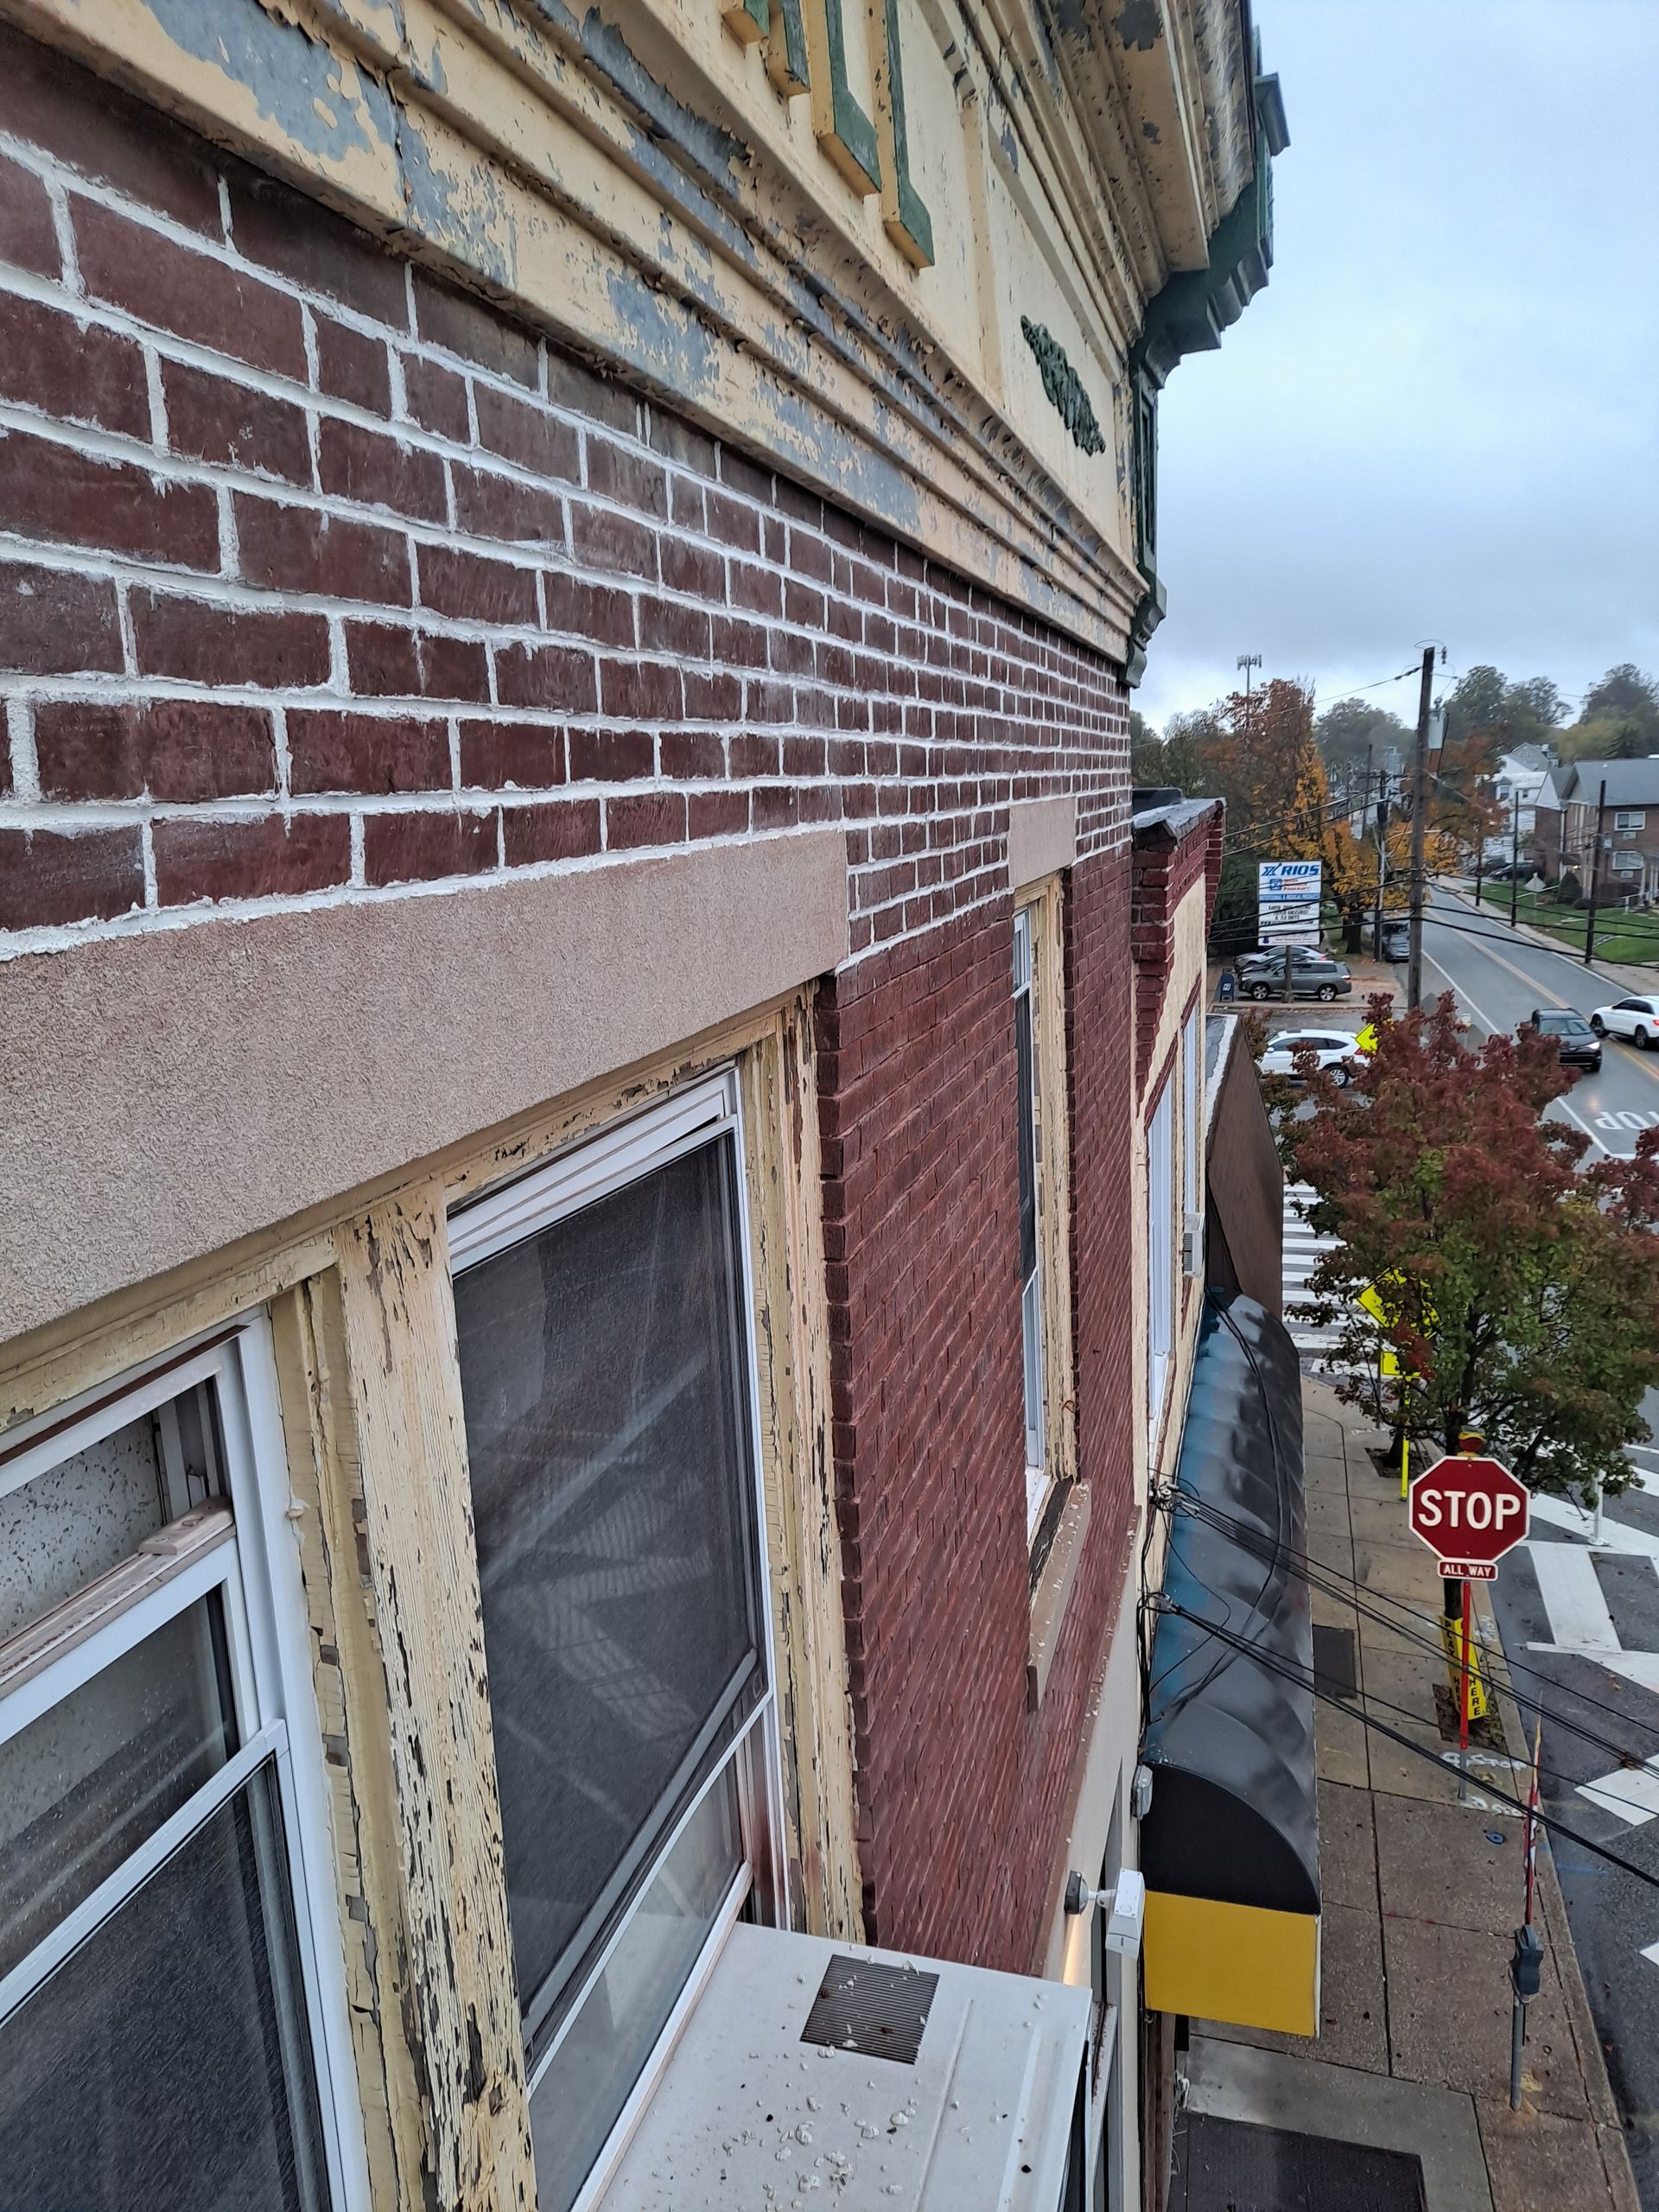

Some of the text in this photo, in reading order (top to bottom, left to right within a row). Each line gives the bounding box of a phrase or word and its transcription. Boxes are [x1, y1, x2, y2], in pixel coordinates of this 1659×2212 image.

[1281, 865, 1320, 875] RIOS
[1418, 1489, 1521, 1530] STOP
[1444, 1564, 1492, 1577] ALL WAY
[1469, 1676, 1482, 1716] HERE
